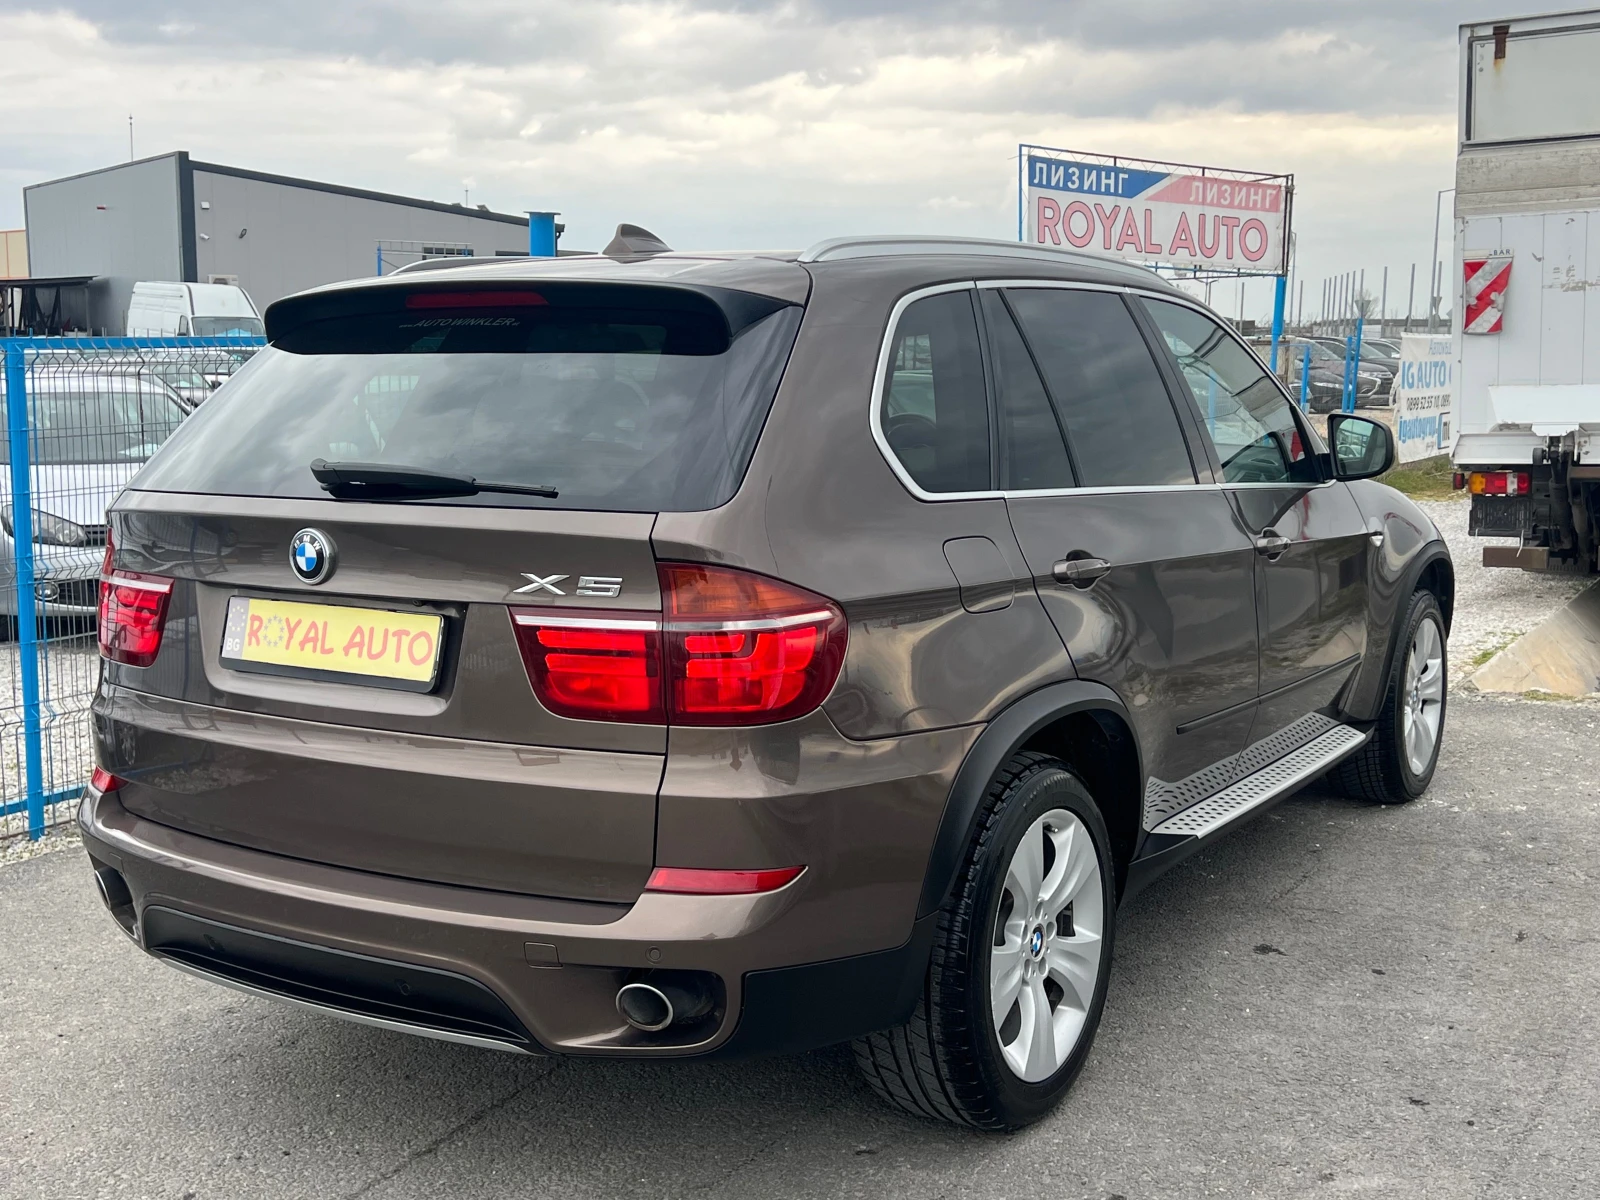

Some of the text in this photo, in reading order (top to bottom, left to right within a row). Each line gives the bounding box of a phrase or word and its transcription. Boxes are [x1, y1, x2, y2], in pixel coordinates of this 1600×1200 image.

[1033, 162, 1129, 194] ЛИЗИНГ
[1189, 181, 1277, 209] ЛИЗИНГ
[1037, 196, 1268, 262] ROYAL AUTO
[1493, 248, 1511, 256] BAR
[1401, 360, 1415, 389] IG
[1416, 360, 1446, 389] AUTO
[294, 534, 322, 551] BMW
[513, 572, 623, 598] X5
[225, 637, 241, 652] BG
[342, 625, 434, 666] AUTO
